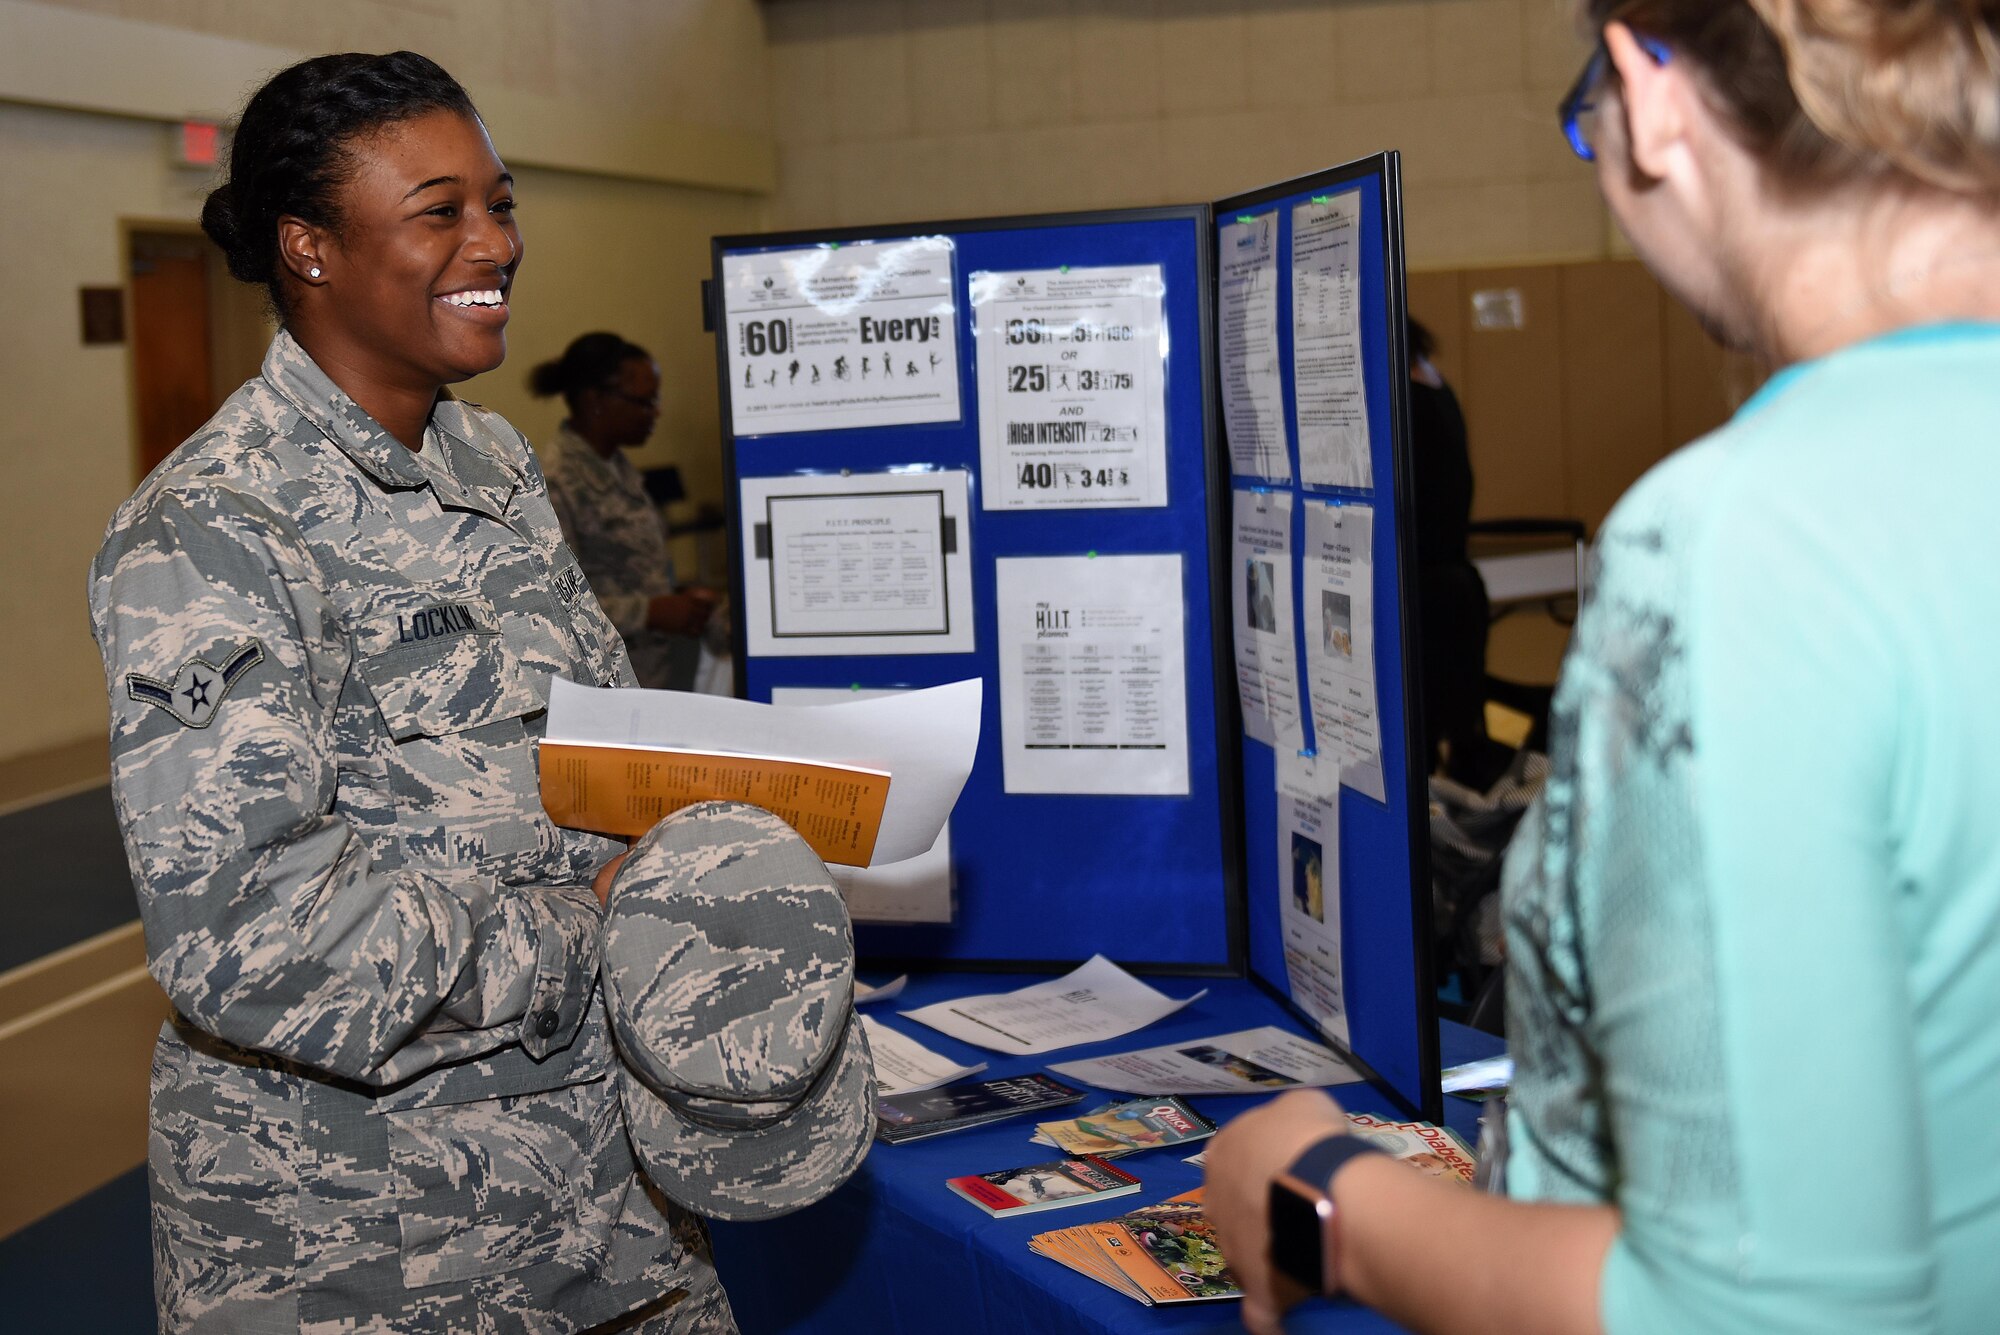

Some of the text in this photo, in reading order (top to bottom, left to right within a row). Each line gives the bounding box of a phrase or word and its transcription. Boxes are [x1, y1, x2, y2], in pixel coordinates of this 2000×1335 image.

[745, 320, 788, 356] 60
[860, 316, 931, 345] Every
[1061, 351, 1078, 361] OR
[1012, 365, 1045, 393] 25
[1081, 370, 1092, 391] 3
[1113, 374, 1131, 390] 75
[1059, 406, 1084, 417] AND
[1010, 422, 1035, 445] HIGH
[1036, 421, 1087, 445] INTENSITY
[1103, 428, 1112, 442] 2
[1020, 462, 1052, 489] 40
[1036, 601, 1050, 611] my
[1416, 1128, 1476, 1183] Diabete
